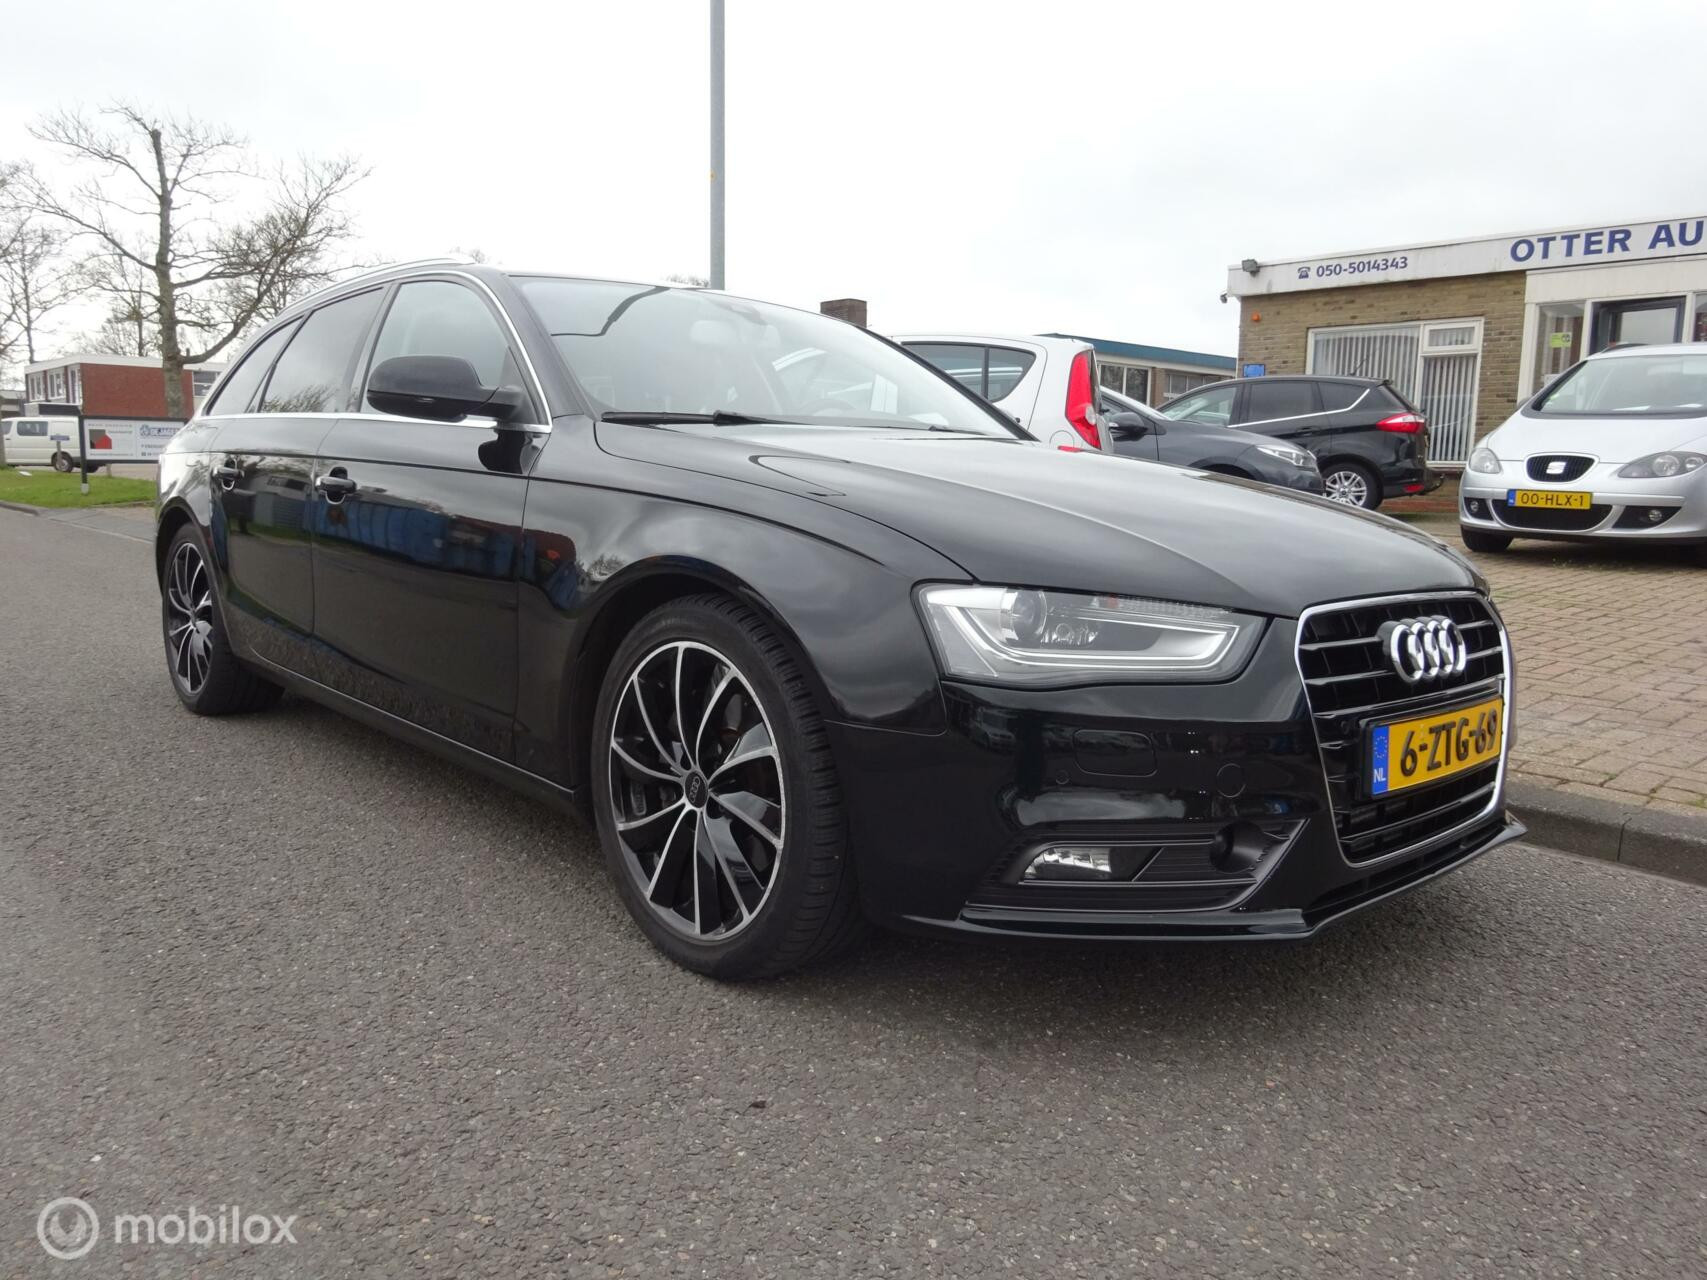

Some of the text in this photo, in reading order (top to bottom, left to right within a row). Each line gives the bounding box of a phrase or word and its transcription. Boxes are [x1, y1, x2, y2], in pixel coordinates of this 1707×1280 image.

[1510, 220, 1704, 262] OTTER AU
[1316, 256, 1408, 278] 050-5014343
[1520, 492, 1584, 507] 00-HLX-1
[1400, 708, 1498, 778] 6-ZTG-69
[1373, 767, 1387, 783] NL
